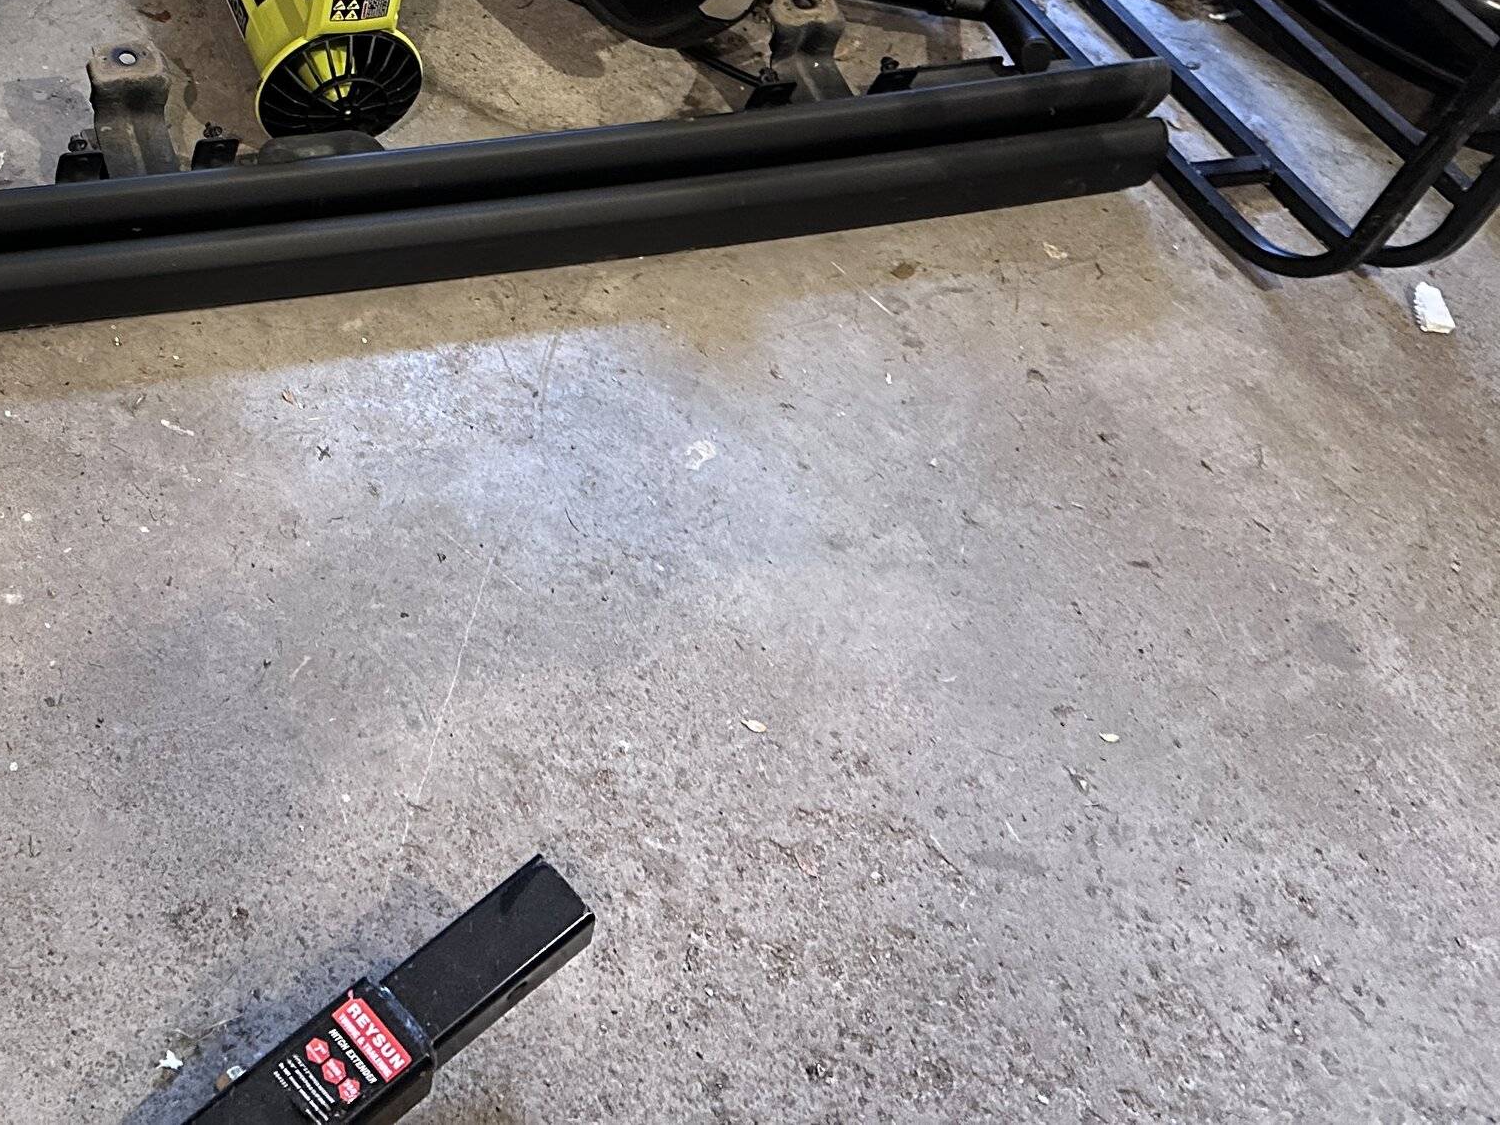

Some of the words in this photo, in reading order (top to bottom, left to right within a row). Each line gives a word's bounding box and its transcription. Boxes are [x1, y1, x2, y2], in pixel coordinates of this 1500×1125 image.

[328, 1028, 351, 1051] HITCH
[345, 1048, 378, 1085] EXTENDER
[346, 1002, 406, 1070] REYSUN
